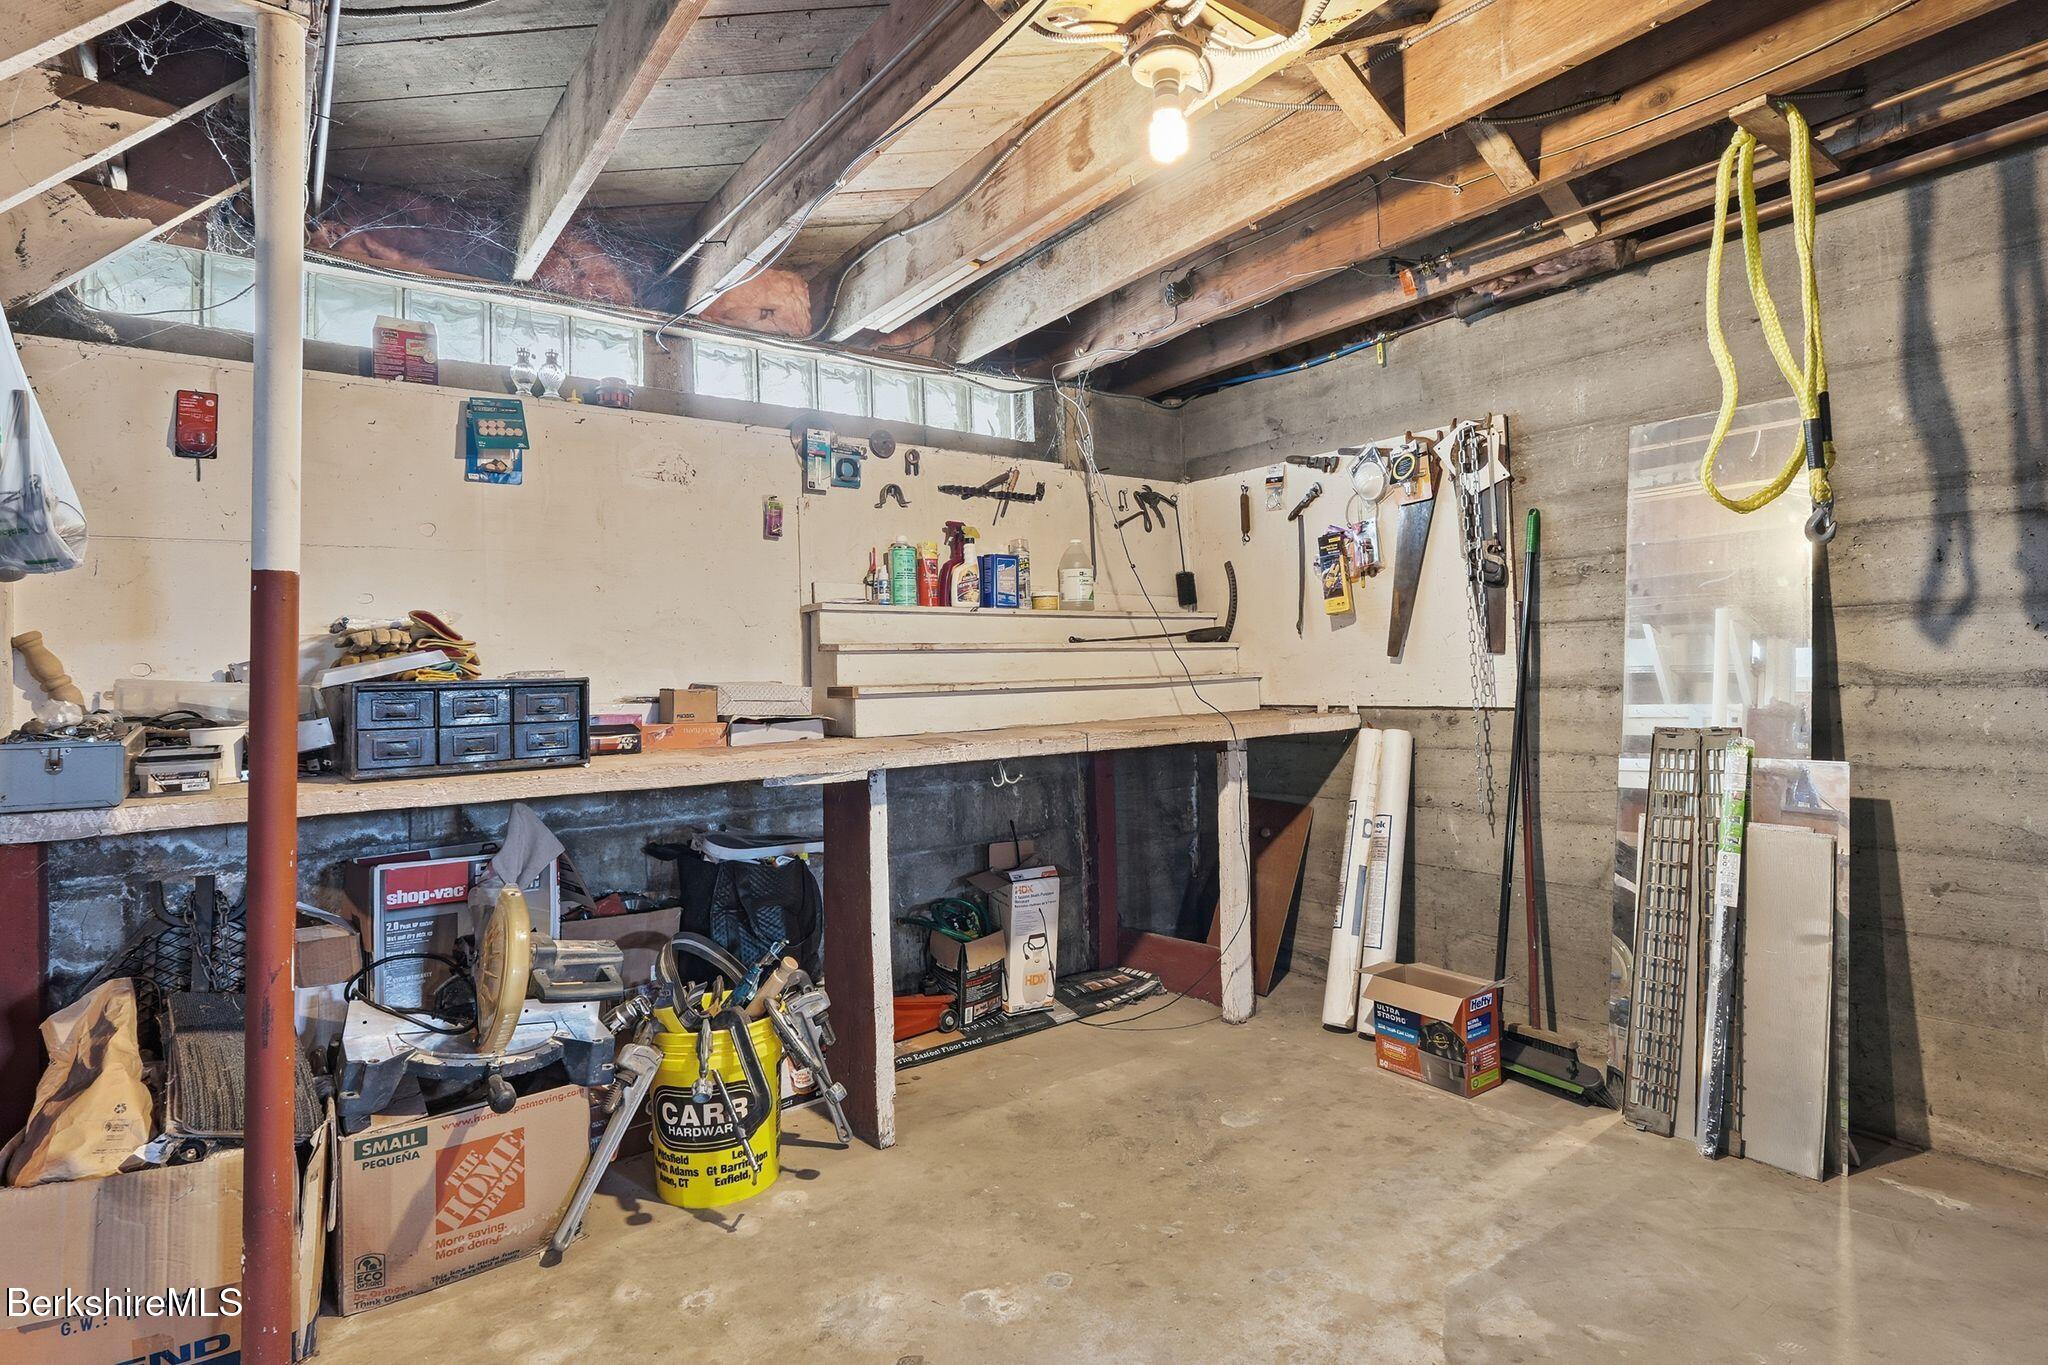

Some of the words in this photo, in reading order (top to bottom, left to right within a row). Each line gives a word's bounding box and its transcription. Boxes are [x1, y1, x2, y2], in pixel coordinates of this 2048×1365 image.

[1025, 973, 1047, 986] HDX
[1376, 1004, 1400, 1016] ULTRA
[1470, 993, 1493, 1012] Hefty
[1377, 1011, 1406, 1025] STRONG
[668, 1123, 734, 1138] HARDWAR
[361, 1131, 419, 1157] SMALL
[361, 1150, 421, 1171] PEQUEÑA
[444, 1149, 483, 1188] THE
[669, 1165, 699, 1177] Adams
[706, 1166, 718, 1177] Gt
[435, 1130, 525, 1230] HOME
[678, 1178, 690, 1188] CT
[472, 1158, 525, 1222] DEPOT
[435, 1235, 464, 1250] More
[468, 1222, 508, 1243] saving.
[435, 1245, 465, 1260] More
[356, 1271, 383, 1285] ECO
